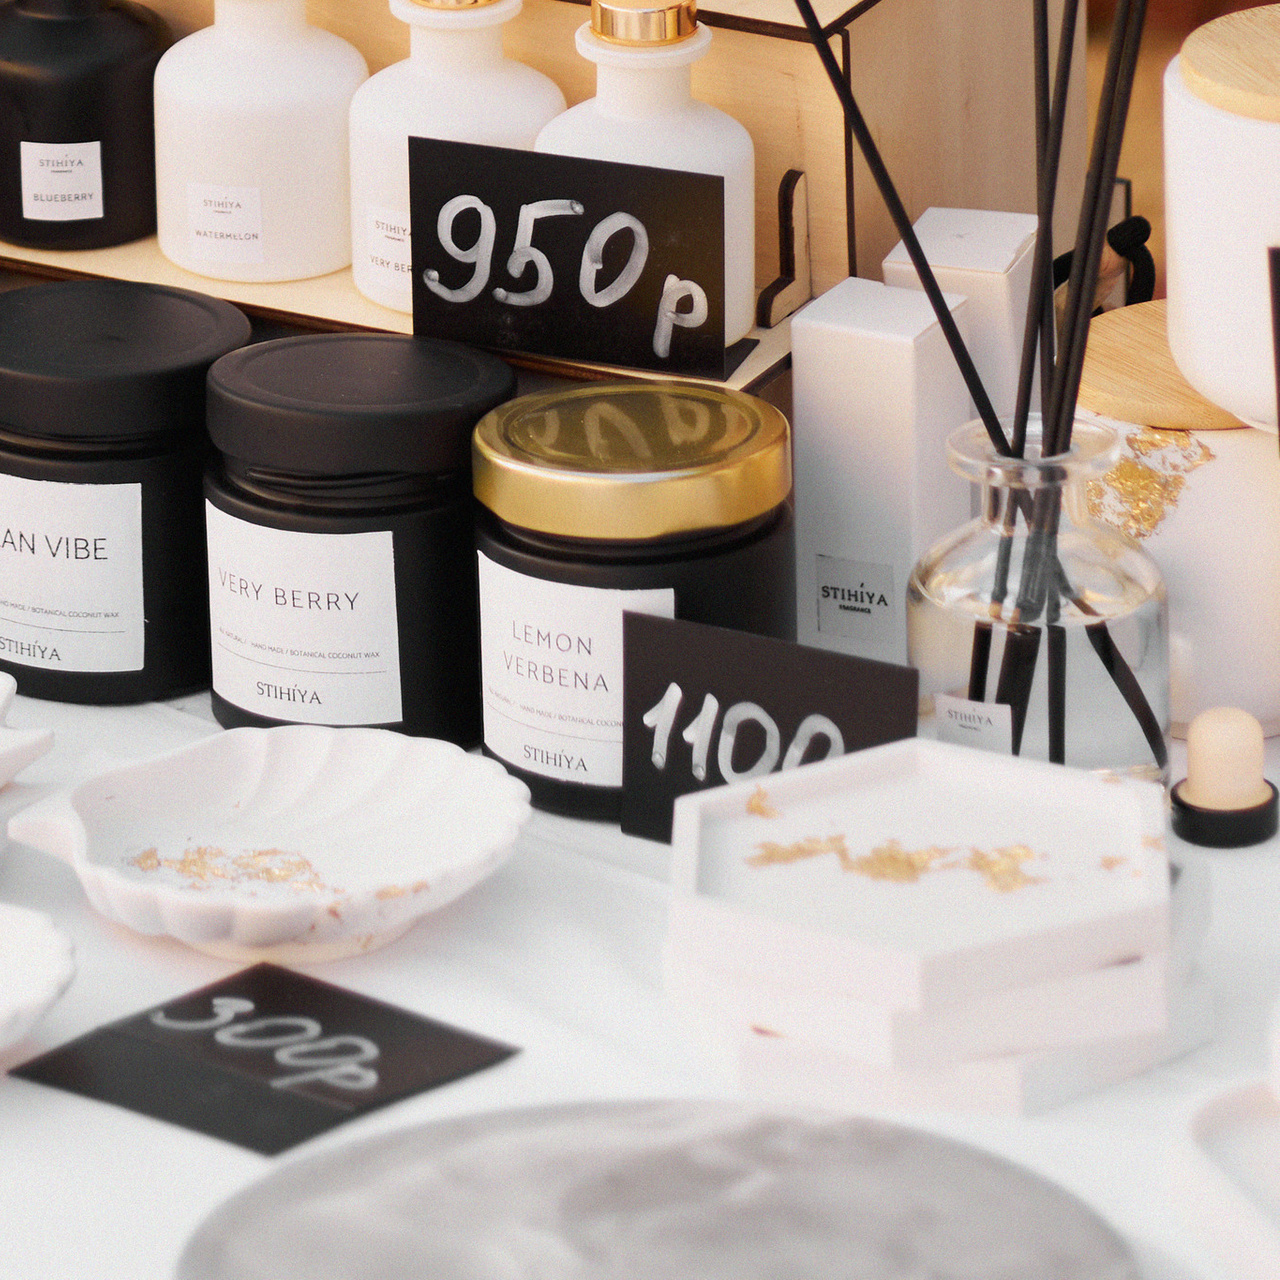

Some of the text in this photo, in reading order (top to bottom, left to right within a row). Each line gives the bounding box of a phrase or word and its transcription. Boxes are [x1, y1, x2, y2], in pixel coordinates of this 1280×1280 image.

[33, 192, 94, 202] BLUEBERRY
[195, 229, 259, 241] WATERMELON
[370, 255, 412, 273] VERY BER
[45, 534, 108, 560] VIBE
[219, 567, 360, 611] VERY BERRY
[31, 606, 67, 618] BOTANICAL
[69, 611, 102, 619] COCONUT
[513, 620, 592, 655] LEMON
[290, 649, 327, 659] BOTANICAL
[328, 652, 362, 660] COCONUT
[364, 651, 380, 659] WAX
[503, 650, 609, 692] VERBENA
[596, 719, 623, 728] COCON
